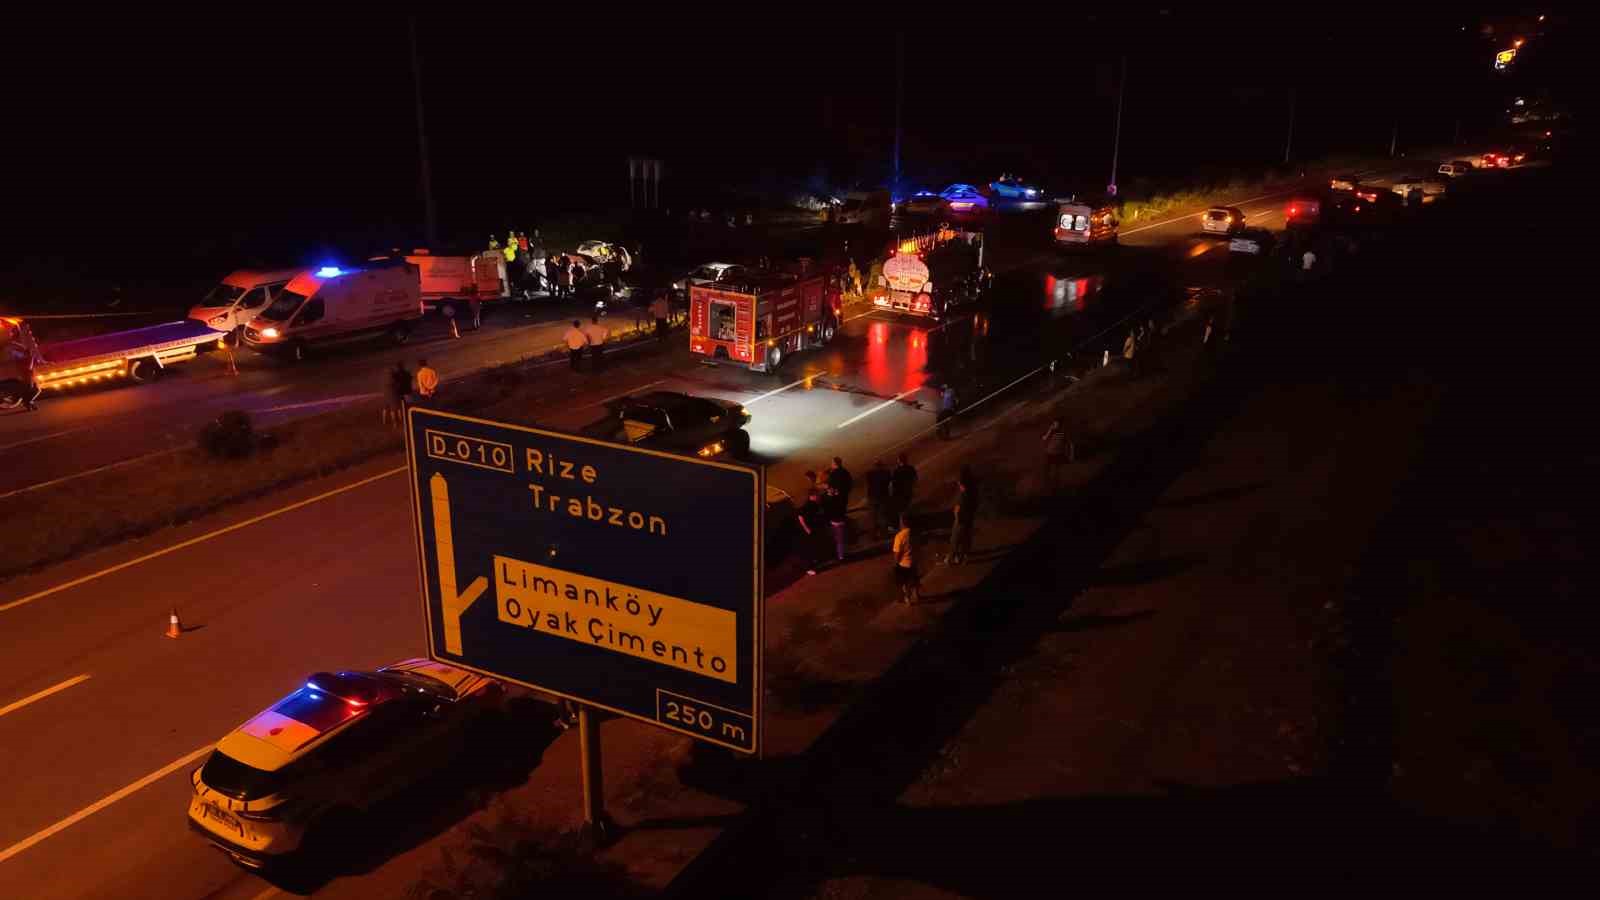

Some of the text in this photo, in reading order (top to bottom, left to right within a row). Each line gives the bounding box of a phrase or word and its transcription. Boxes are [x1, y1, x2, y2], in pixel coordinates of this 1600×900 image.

[526, 448, 598, 483] Rize
[528, 484, 667, 535] Trabzon
[502, 563, 664, 626] Limanköy
[505, 597, 727, 675] Oyak Çimento
[665, 701, 746, 742] 250 m
